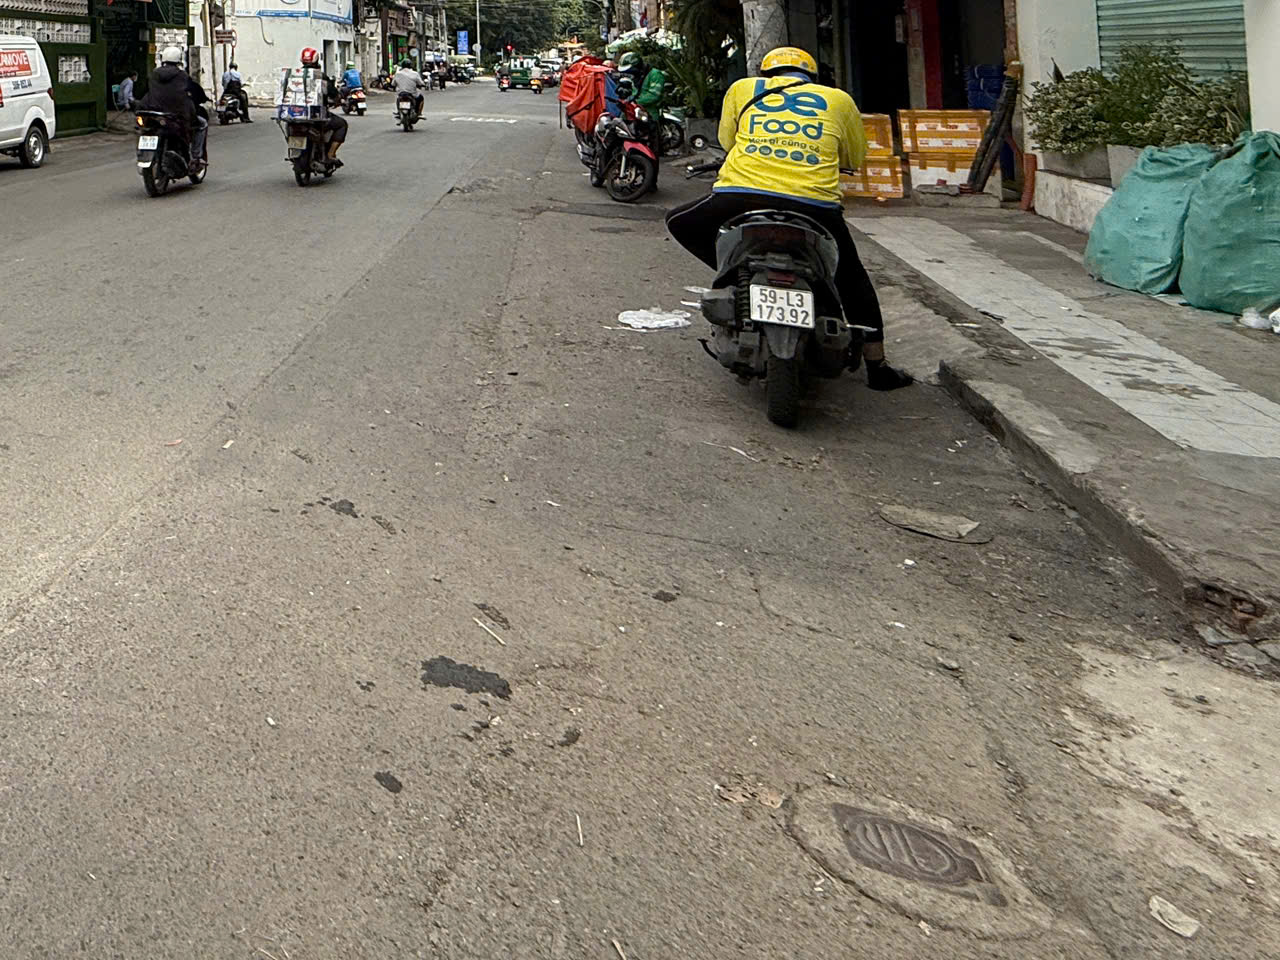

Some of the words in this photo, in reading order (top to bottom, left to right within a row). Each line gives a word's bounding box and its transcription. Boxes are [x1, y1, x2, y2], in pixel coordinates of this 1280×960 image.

[753, 79, 827, 116] be
[750, 114, 823, 139] Food
[769, 137, 779, 146] gì
[781, 139, 807, 149] cũng
[760, 288, 804, 308] 59-L3
[757, 304, 809, 325] 173.92
